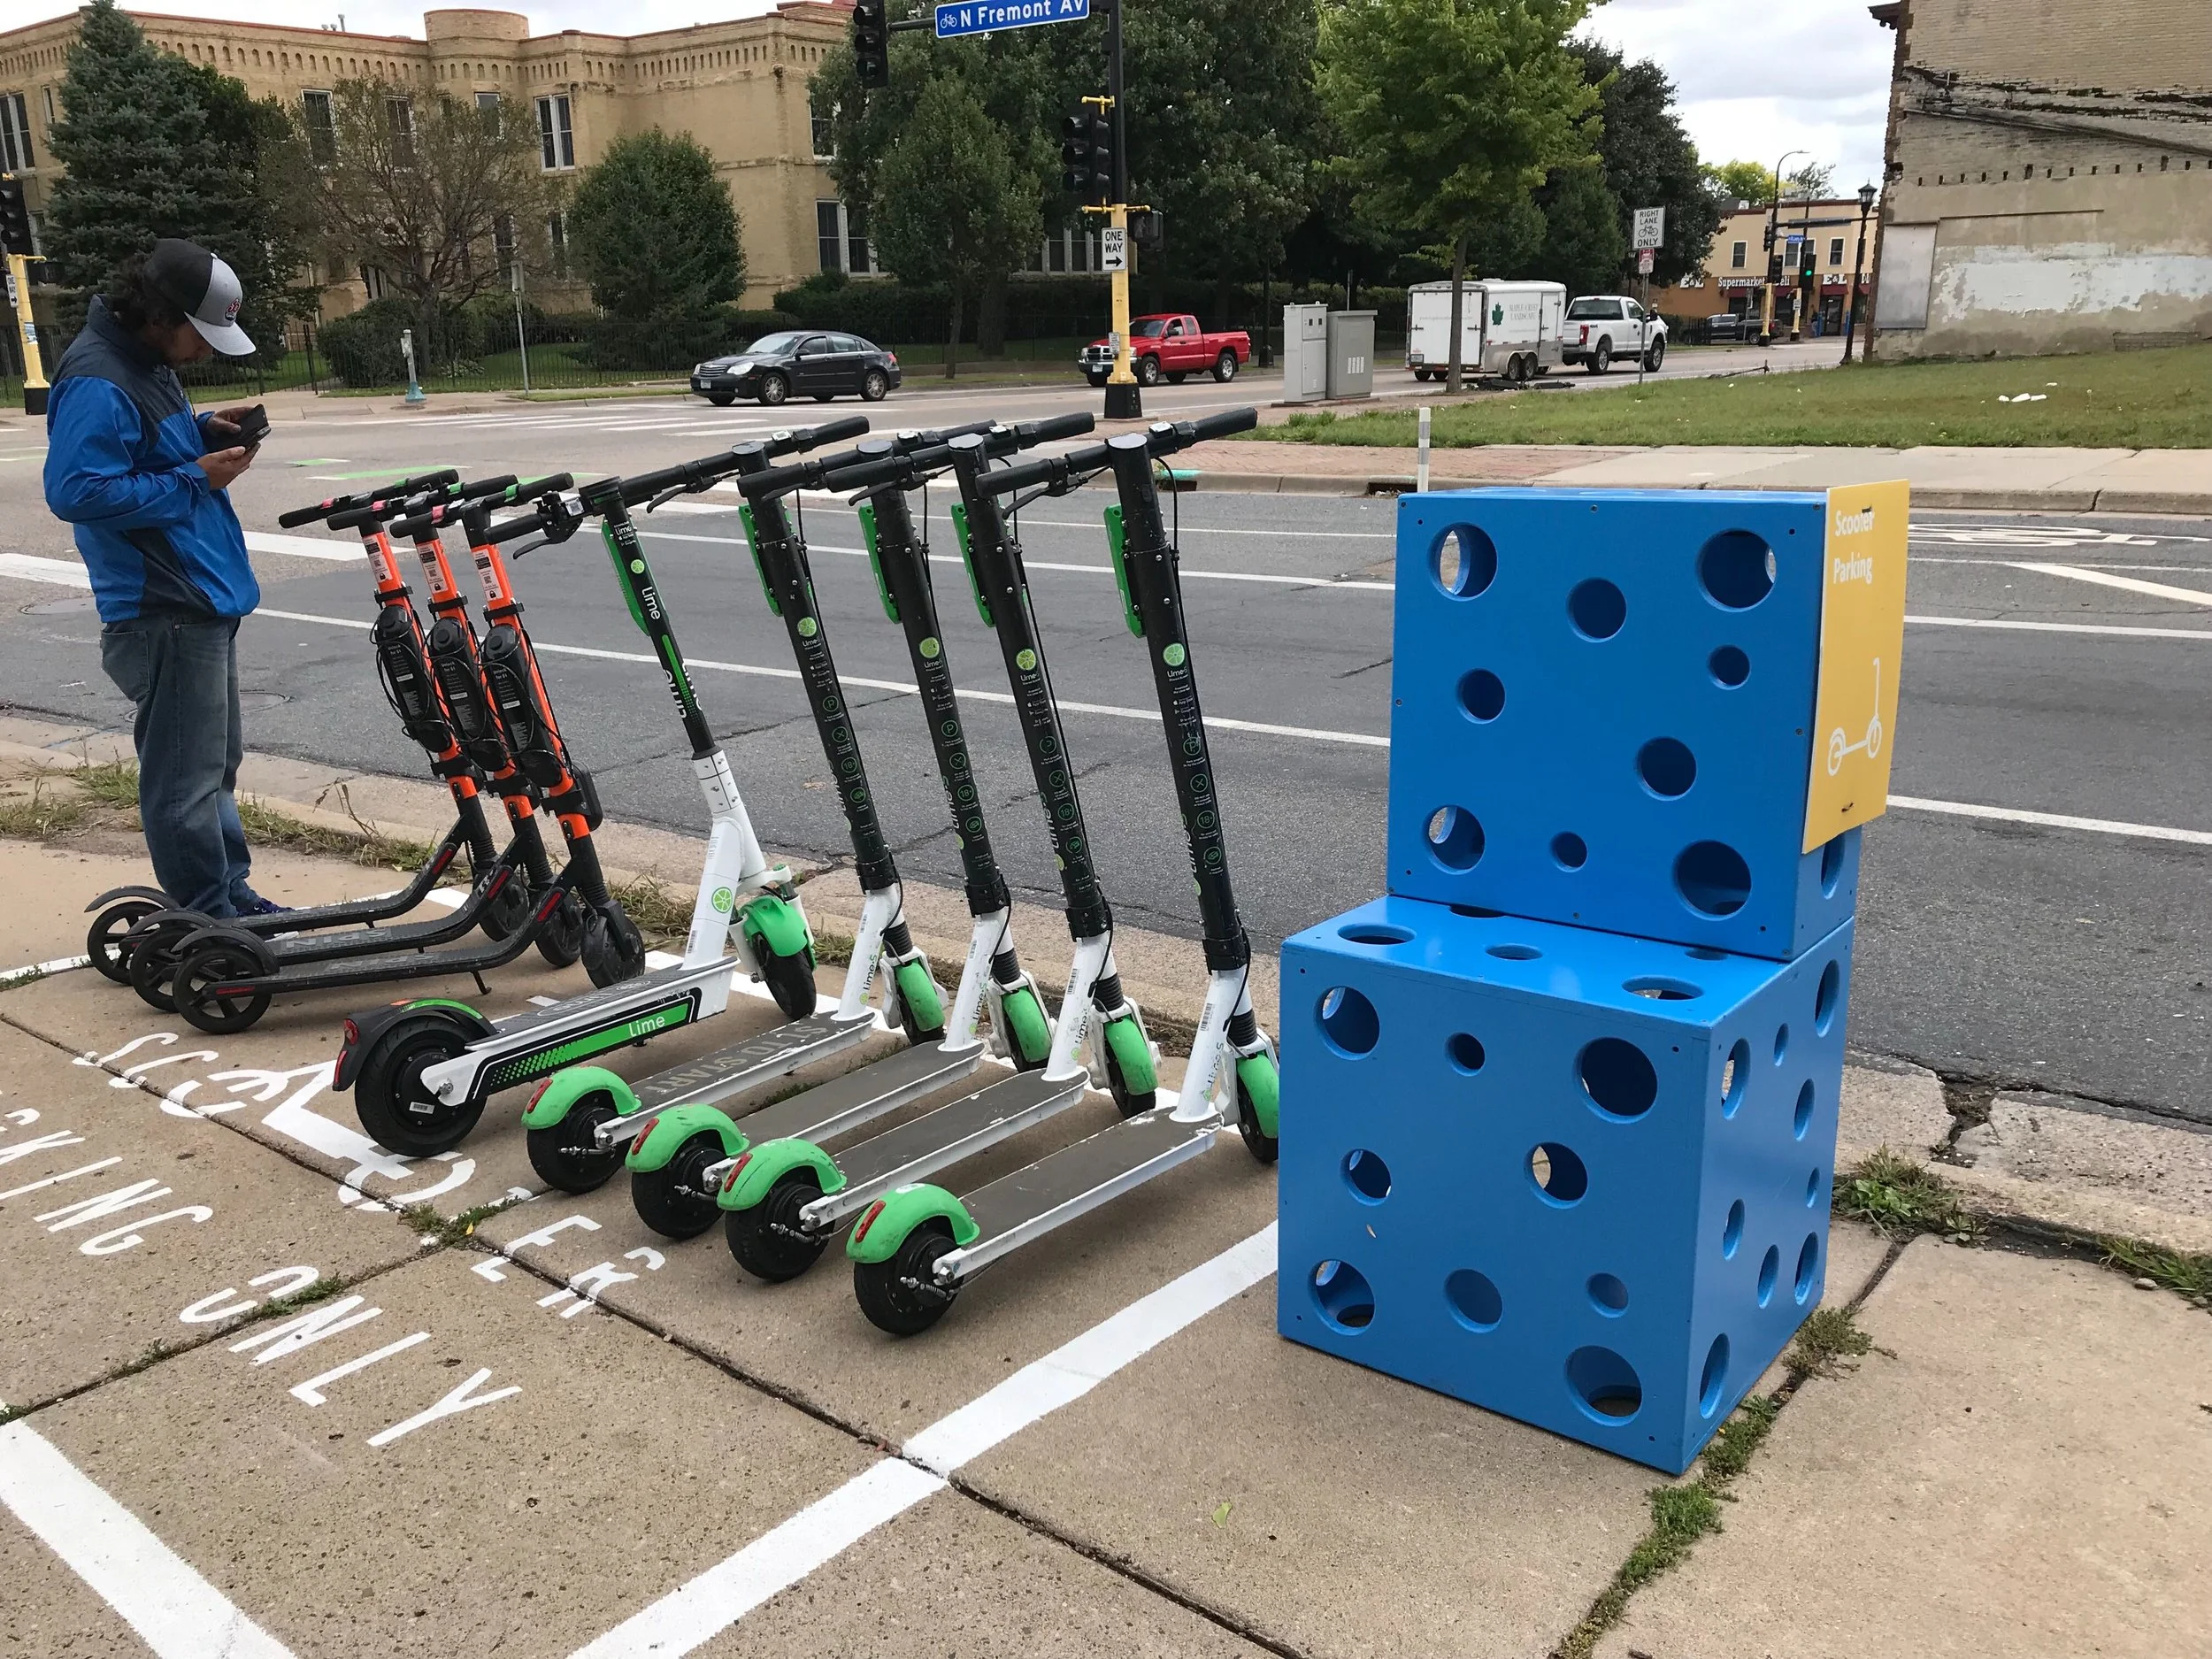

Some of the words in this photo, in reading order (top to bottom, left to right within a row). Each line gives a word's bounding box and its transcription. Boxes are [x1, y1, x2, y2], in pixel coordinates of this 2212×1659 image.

[960, 10, 972, 27] N
[978, 0, 1051, 25] Fremont
[1639, 210, 1659, 219] RIGHT
[1104, 242, 1123, 253] WAY
[1105, 231, 1123, 242] ONE
[1637, 237, 1658, 247] ONLY
[1717, 276, 1766, 290] Supermarket
[1834, 509, 1875, 537] Scooter
[1832, 551, 1873, 585] Parking
[641, 586, 661, 620] Lime
[285, 928, 388, 949] SPIN
[628, 1016, 665, 1038] Lime
[644, 1056, 748, 1094] START
[0, 1089, 213, 1256] KING
[179, 1265, 522, 1447] ONLY
